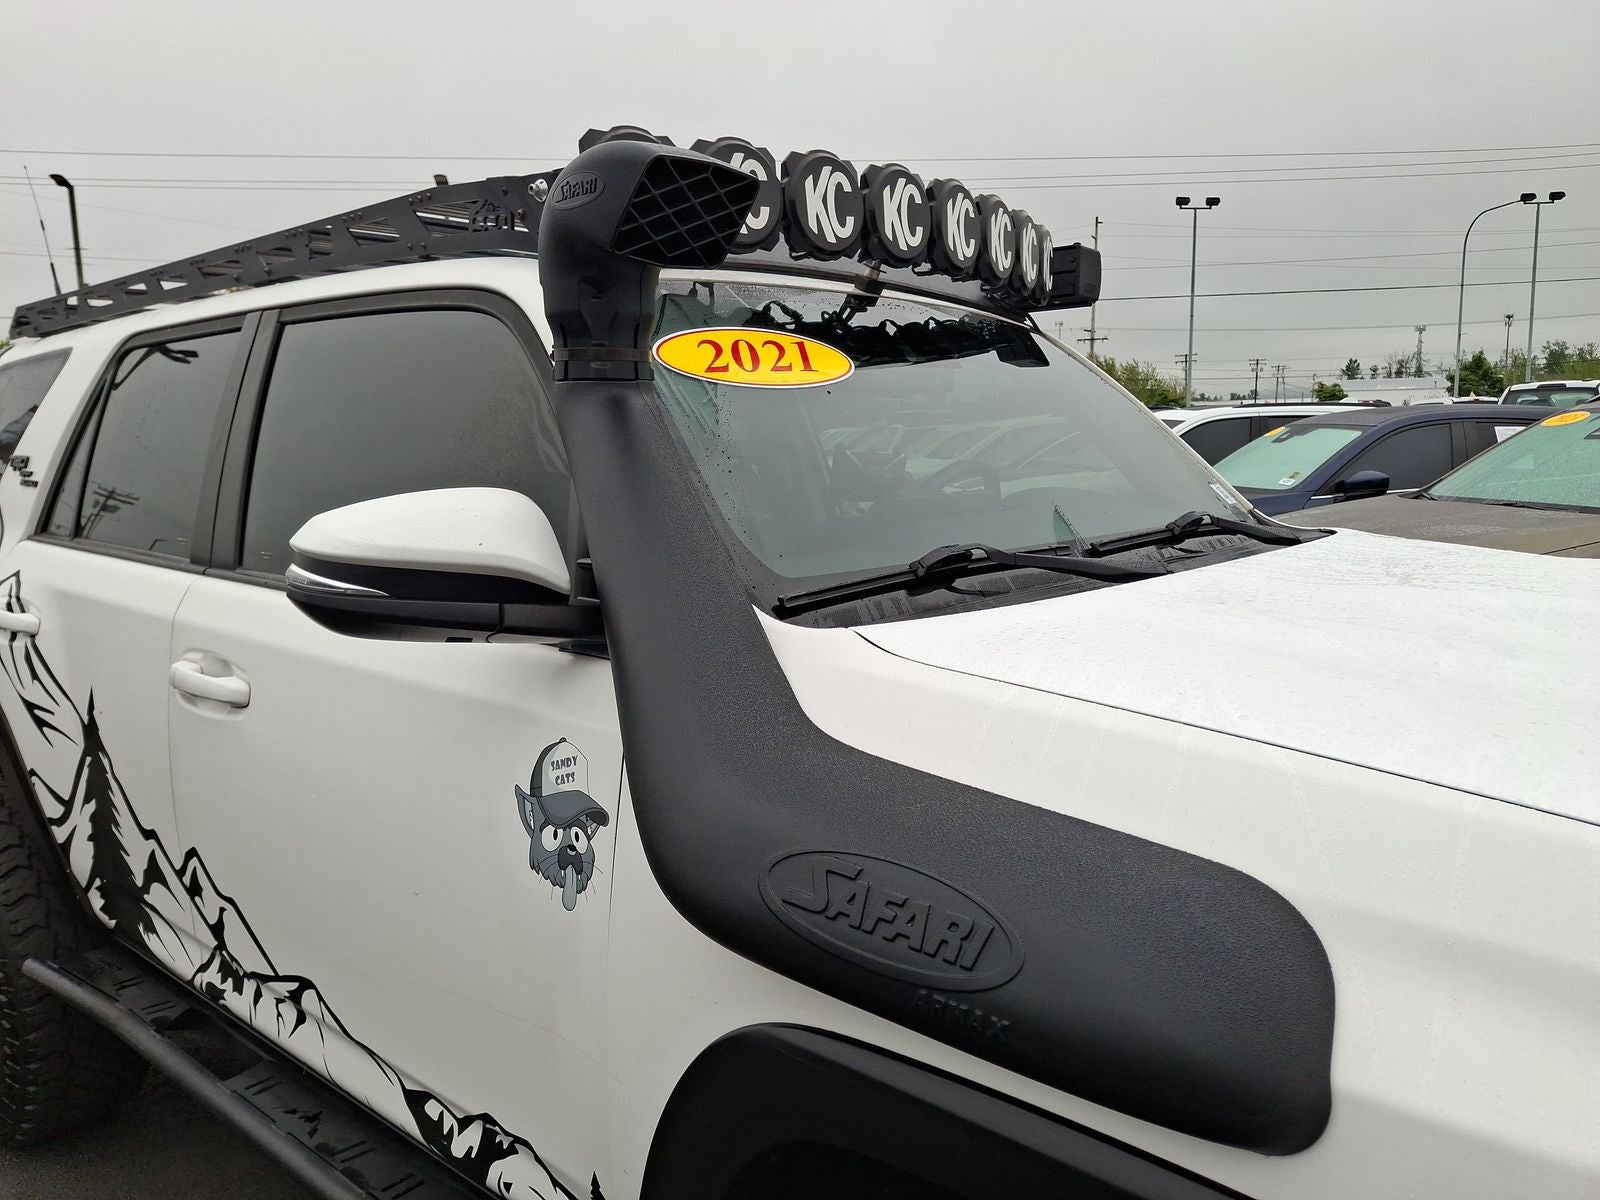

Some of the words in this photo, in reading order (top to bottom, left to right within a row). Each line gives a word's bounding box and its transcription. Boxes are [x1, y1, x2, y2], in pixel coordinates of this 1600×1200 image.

[555, 176, 598, 204] SAFARI
[804, 165, 855, 243] KC
[882, 177, 923, 251] KC
[946, 192, 975, 261] KC
[990, 207, 1012, 272] KC
[1022, 222, 1037, 283] KC
[697, 338, 819, 373] 2021
[550, 755, 579, 772] SANDY
[554, 771, 576, 786] CATS
[780, 854, 996, 972] SAFARI
